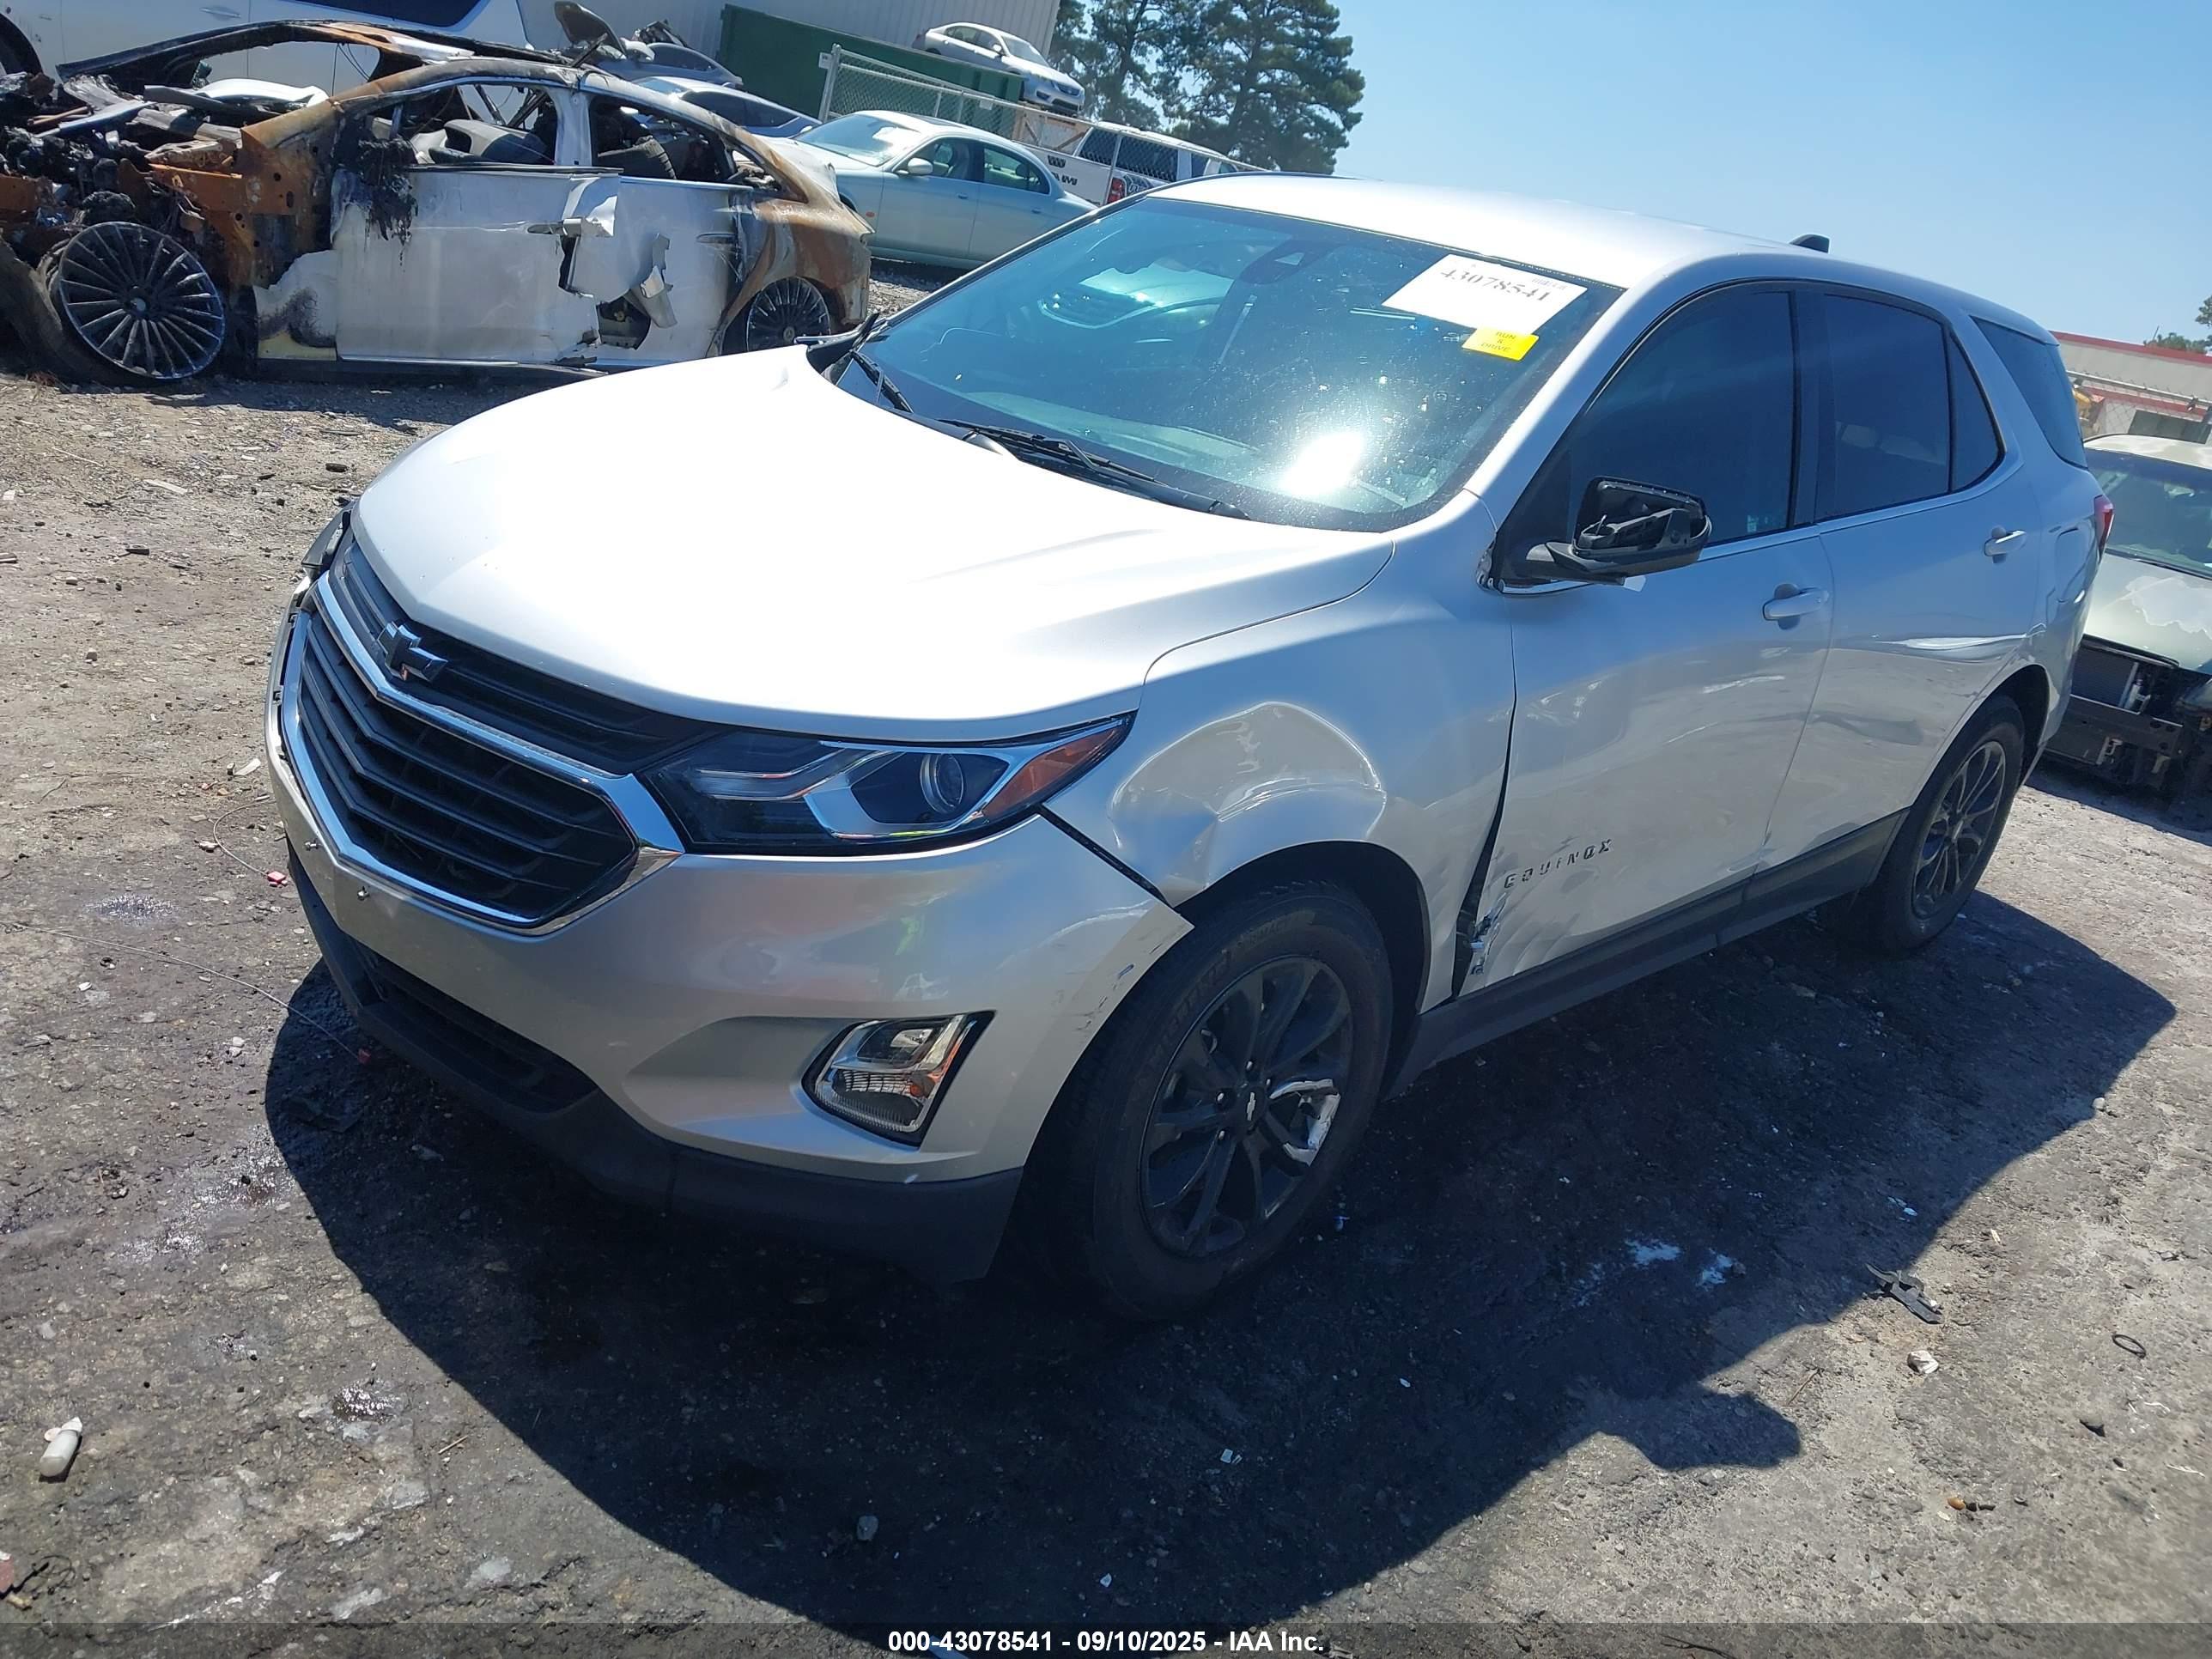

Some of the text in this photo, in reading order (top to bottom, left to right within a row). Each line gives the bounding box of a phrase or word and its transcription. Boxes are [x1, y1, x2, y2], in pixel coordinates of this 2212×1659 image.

[1441, 269, 1552, 301] 43078541
[1495, 331, 1517, 340] RUN
[1480, 342, 1512, 352] DRIVE
[1504, 838, 1613, 889] EQUINOX
